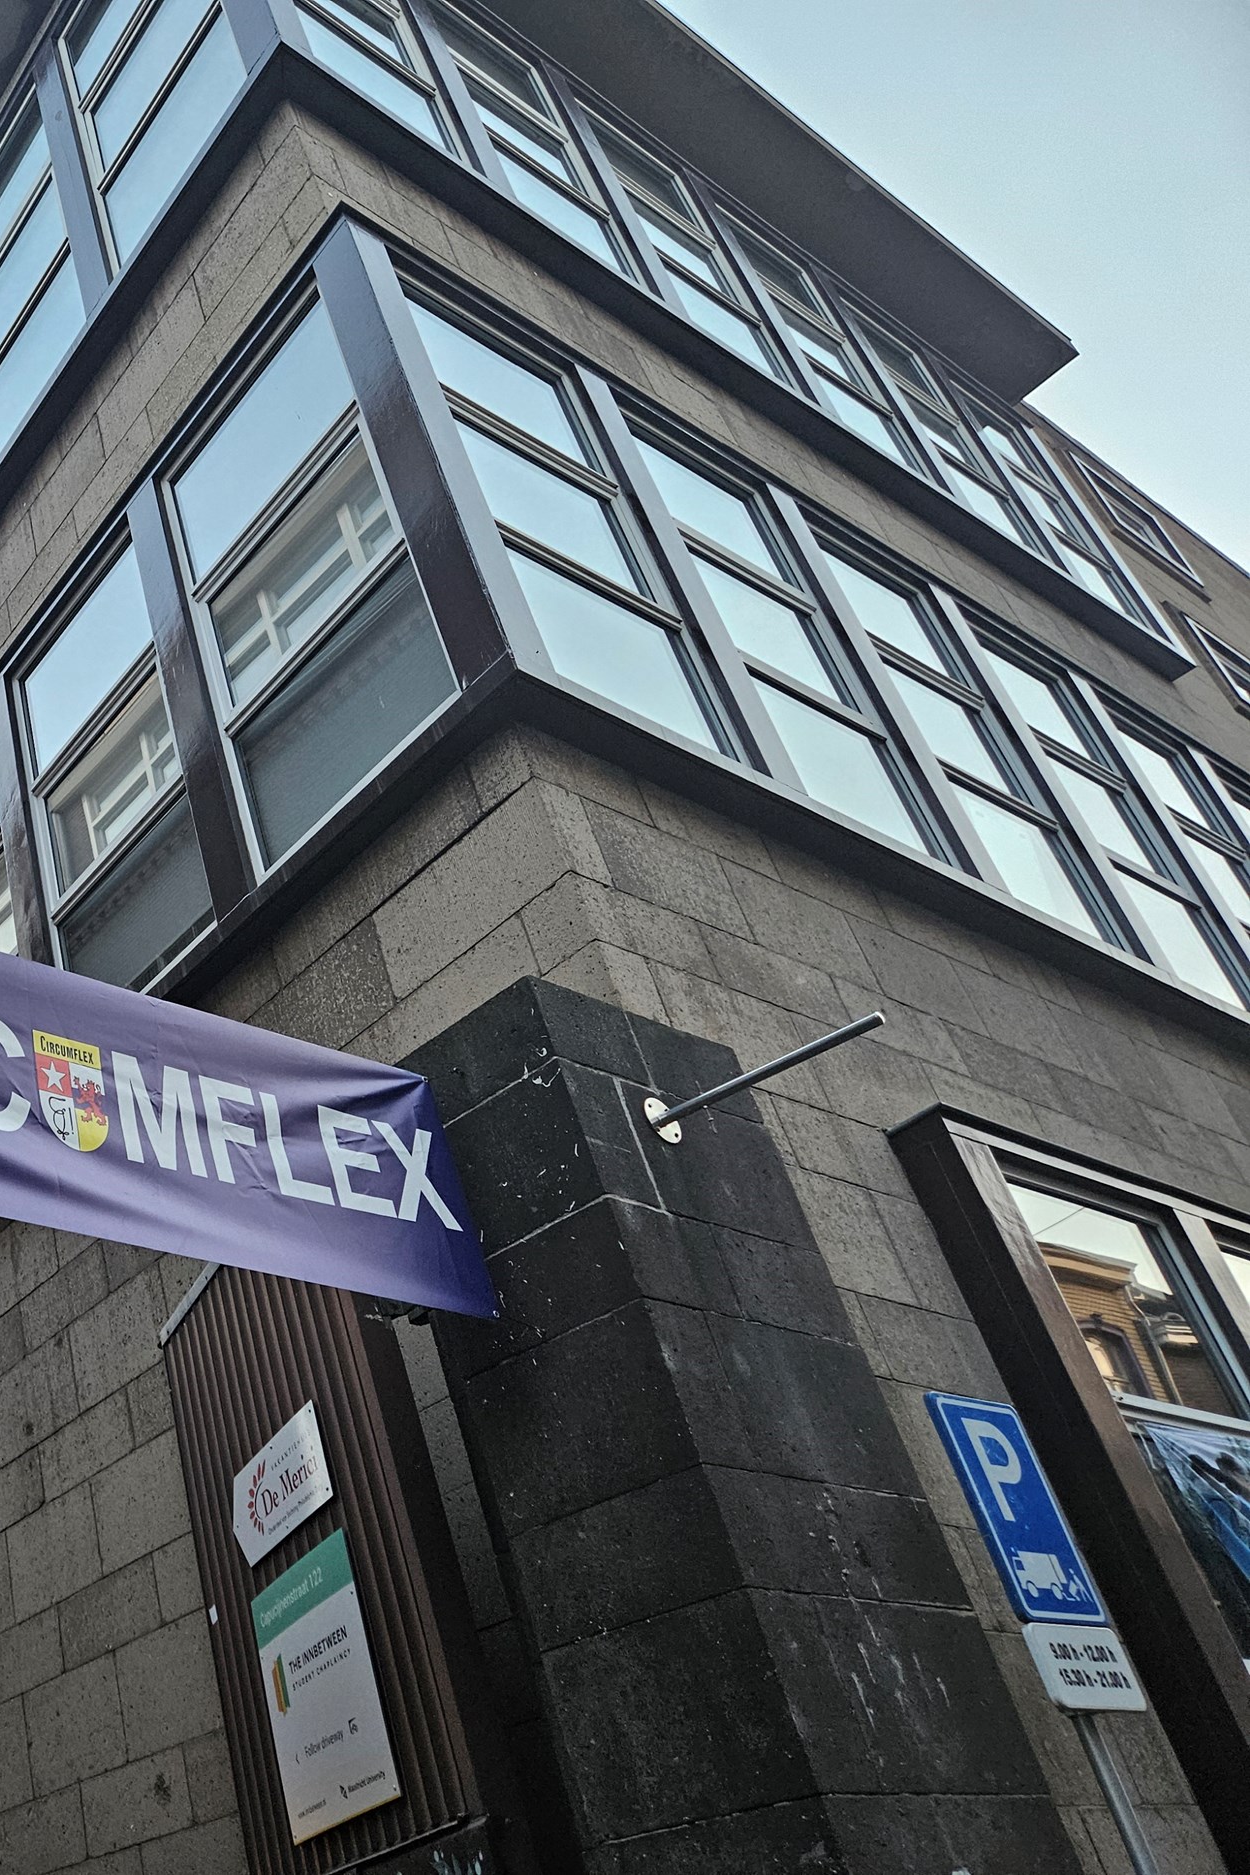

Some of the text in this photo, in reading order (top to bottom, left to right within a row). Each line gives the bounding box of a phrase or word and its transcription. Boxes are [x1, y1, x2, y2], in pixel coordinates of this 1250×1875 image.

[40, 1036, 94, 1065] CIRCUMFLEX
[260, 1489, 279, 1516] De
[279, 1446, 318, 1501] Merici
[961, 1418, 1022, 1522] P
[308, 1567, 323, 1589] 122
[288, 1625, 348, 1675] THE INNBETWEEN
[1049, 1642, 1072, 1660] 9.00
[1069, 1643, 1081, 1661] h
[1083, 1644, 1110, 1663] 12.00
[1106, 1645, 1118, 1663] h
[292, 1648, 352, 1691] STUDENT CHAPLAINCY
[1059, 1667, 1086, 1687] 15.30
[1082, 1668, 1095, 1688] h
[1096, 1670, 1124, 1689] 21.00
[1119, 1670, 1132, 1690] h
